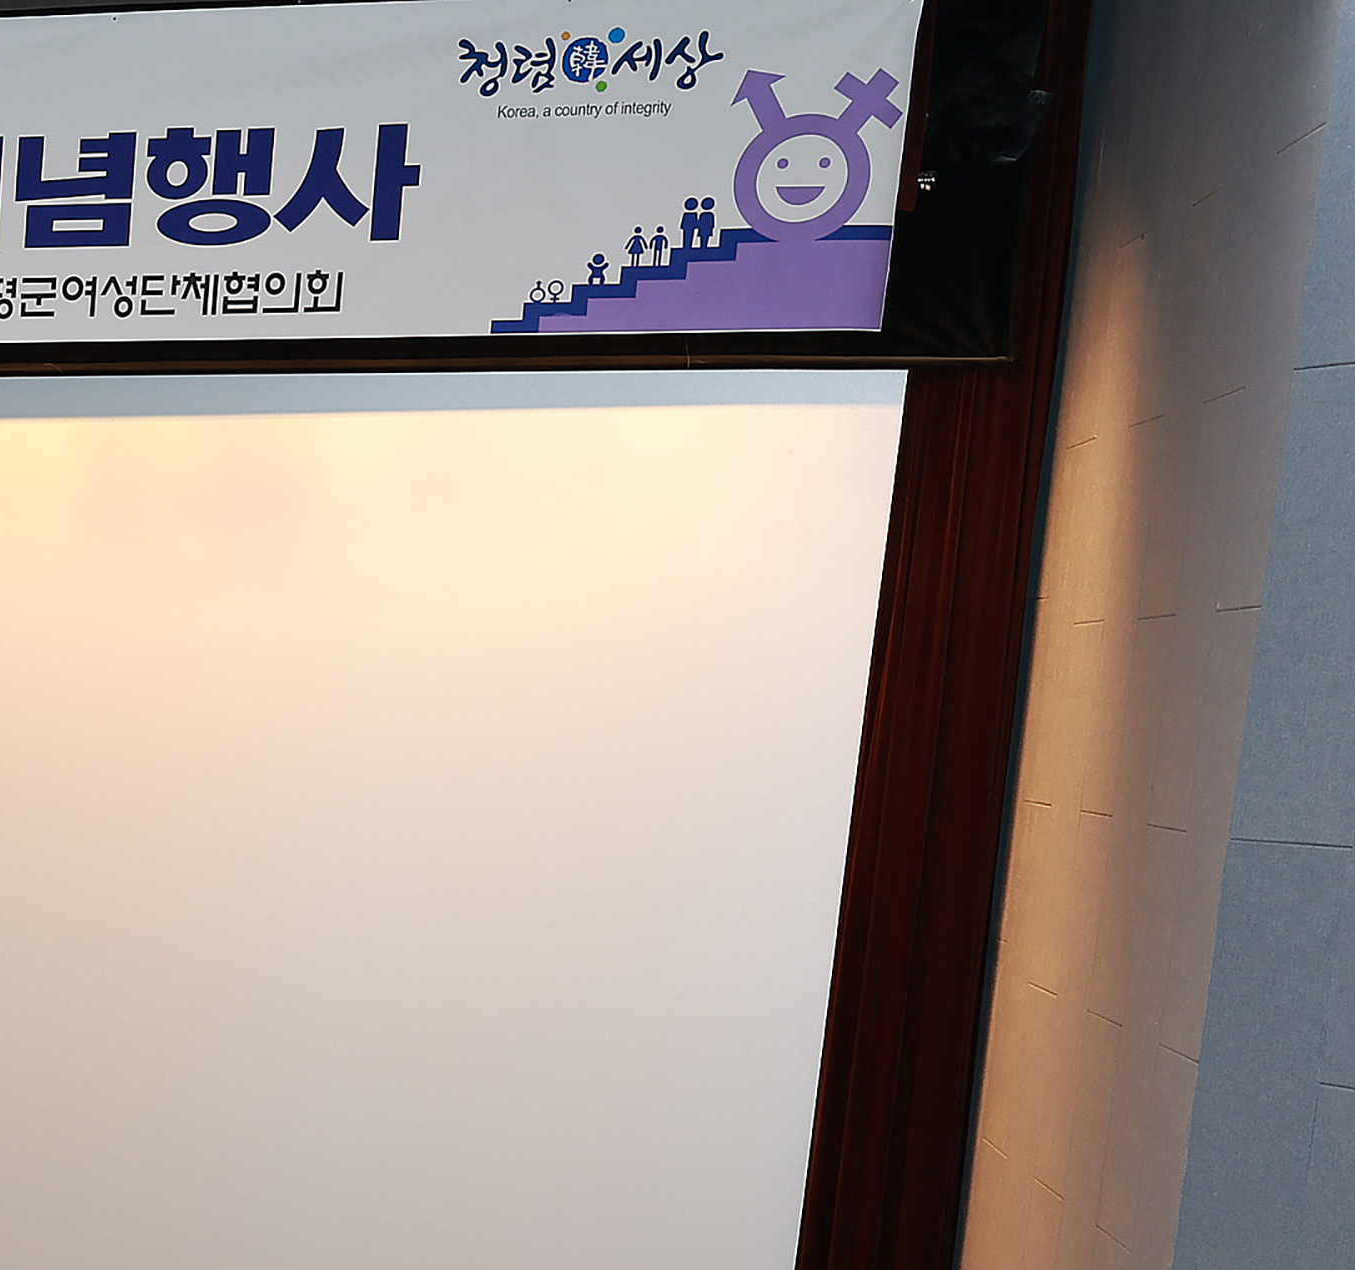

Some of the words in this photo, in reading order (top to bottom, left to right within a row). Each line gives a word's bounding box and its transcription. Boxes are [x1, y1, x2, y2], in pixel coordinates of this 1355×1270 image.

[497, 104, 539, 119] Korea,
[542, 106, 551, 118] a
[554, 102, 602, 119] country
[604, 100, 619, 116] of
[620, 99, 672, 118] integrity
